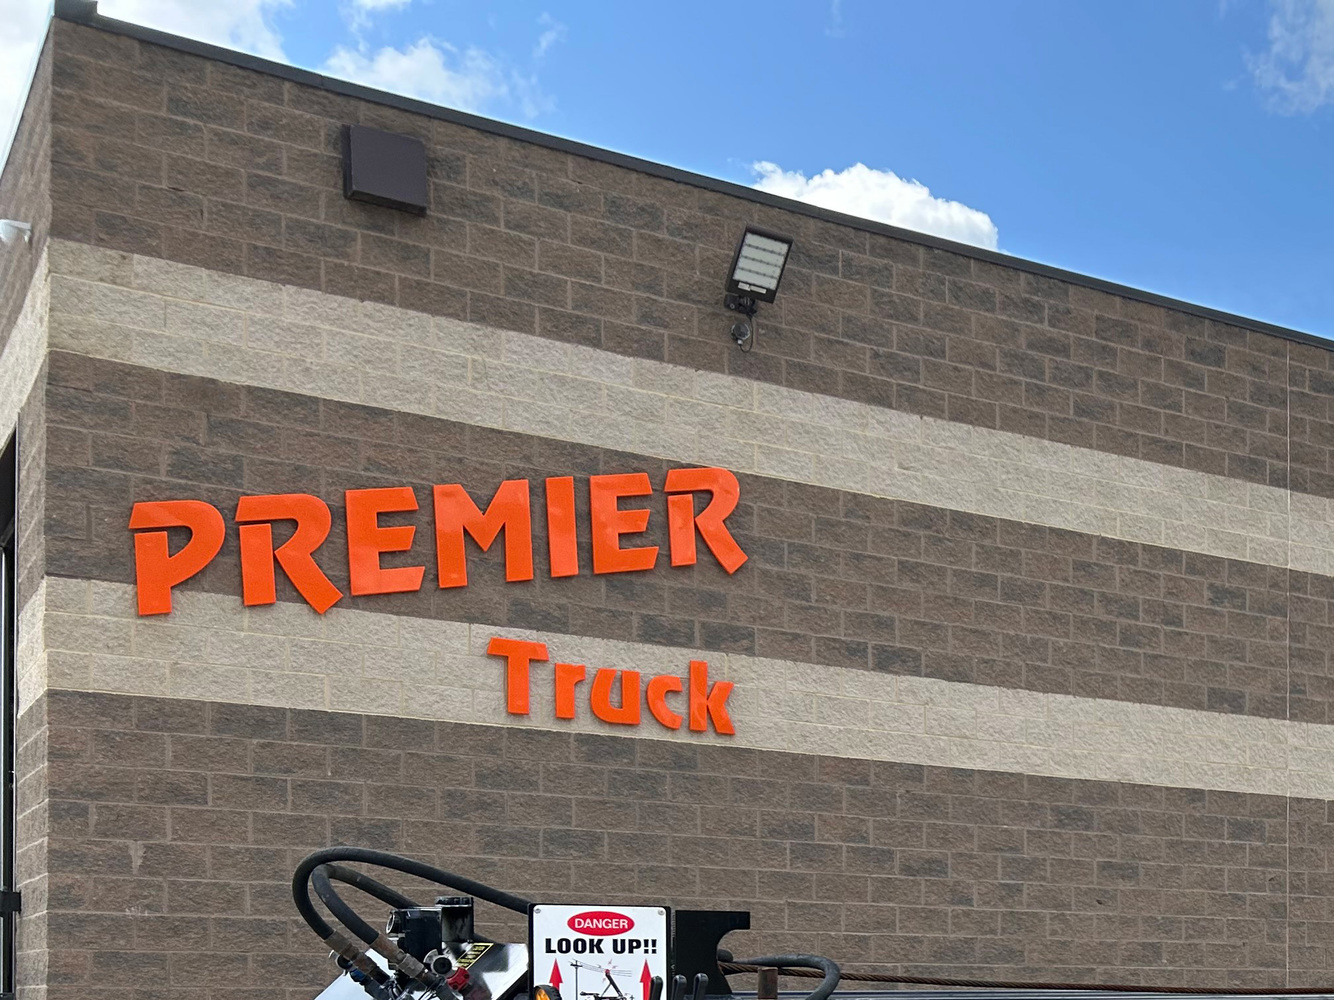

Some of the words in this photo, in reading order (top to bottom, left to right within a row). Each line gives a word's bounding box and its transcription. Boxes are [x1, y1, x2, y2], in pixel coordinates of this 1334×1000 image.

[128, 467, 749, 616] PREMIER
[487, 637, 735, 735] Truck
[545, 938, 604, 954] LOOK
[612, 938, 657, 954] UP!!
[574, 918, 629, 929] DANGER
